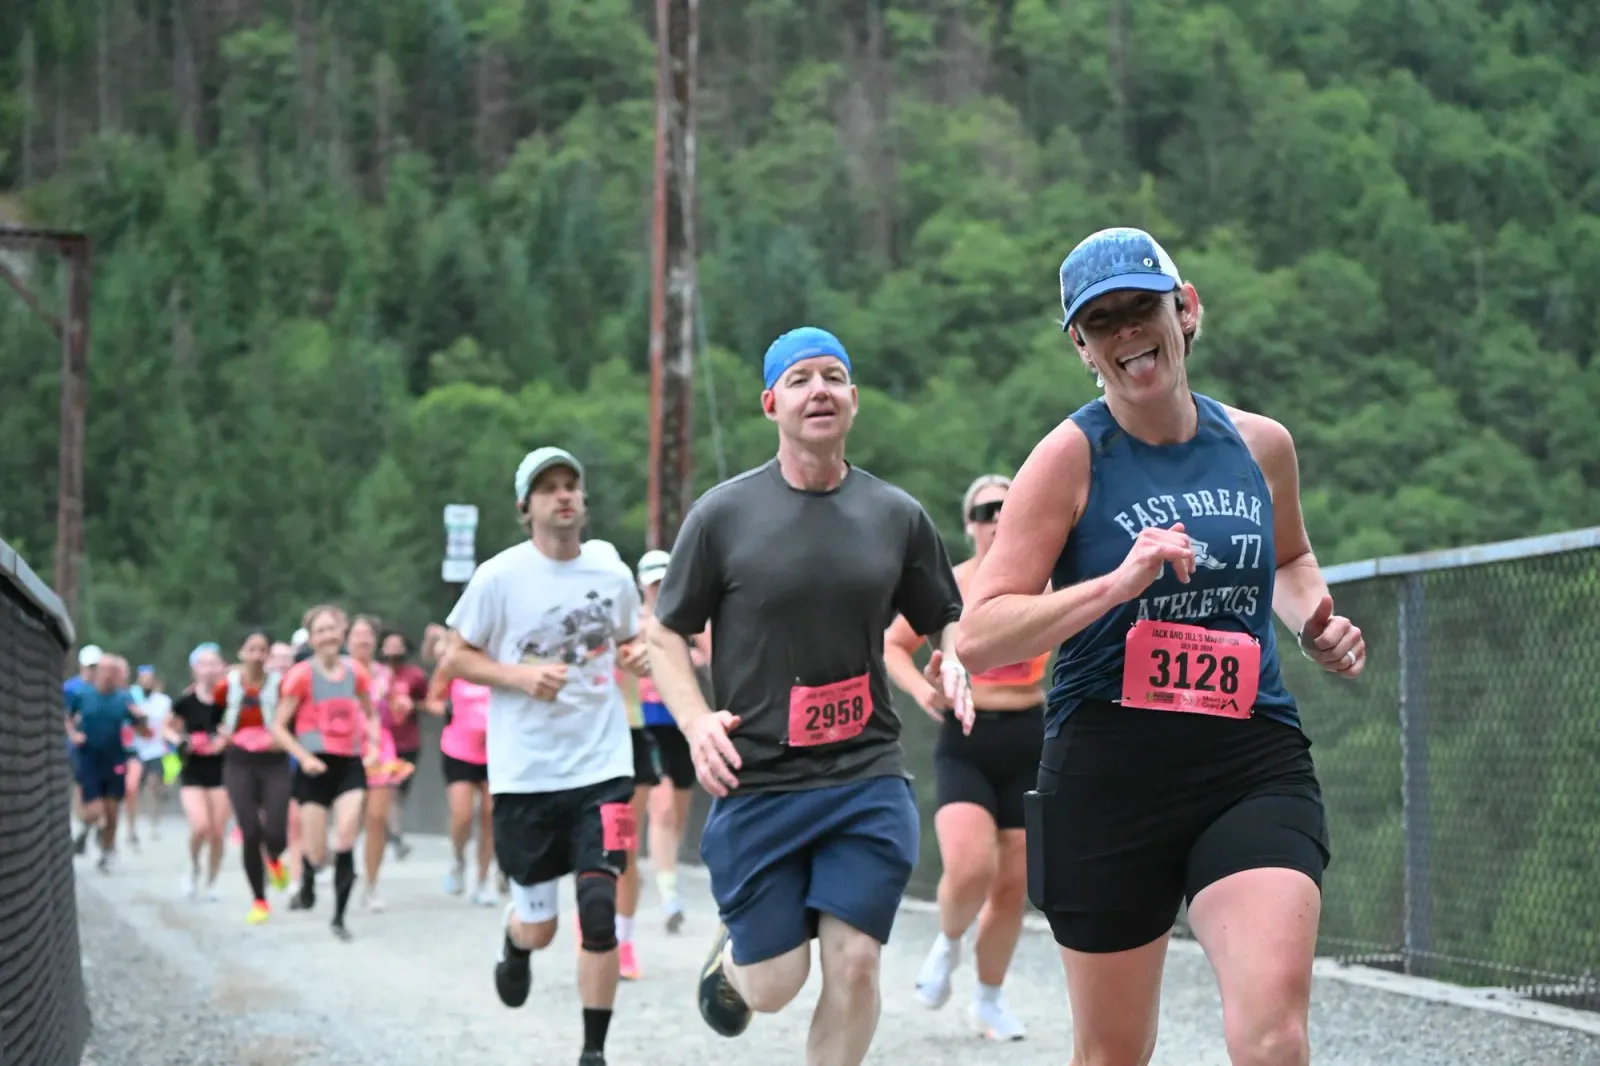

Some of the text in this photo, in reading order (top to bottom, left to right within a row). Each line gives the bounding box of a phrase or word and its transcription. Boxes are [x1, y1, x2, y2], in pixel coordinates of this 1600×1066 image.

[1113, 488, 1263, 540] FAST BREAK
[1230, 534, 1262, 570] 77
[1137, 586, 1258, 622] ATHLETICS
[1152, 628, 1169, 639] JACK
[1169, 631, 1184, 641] AND
[1185, 632, 1203, 642] JILL'S
[1149, 649, 1239, 694] 3128
[805, 695, 864, 731] 2958
